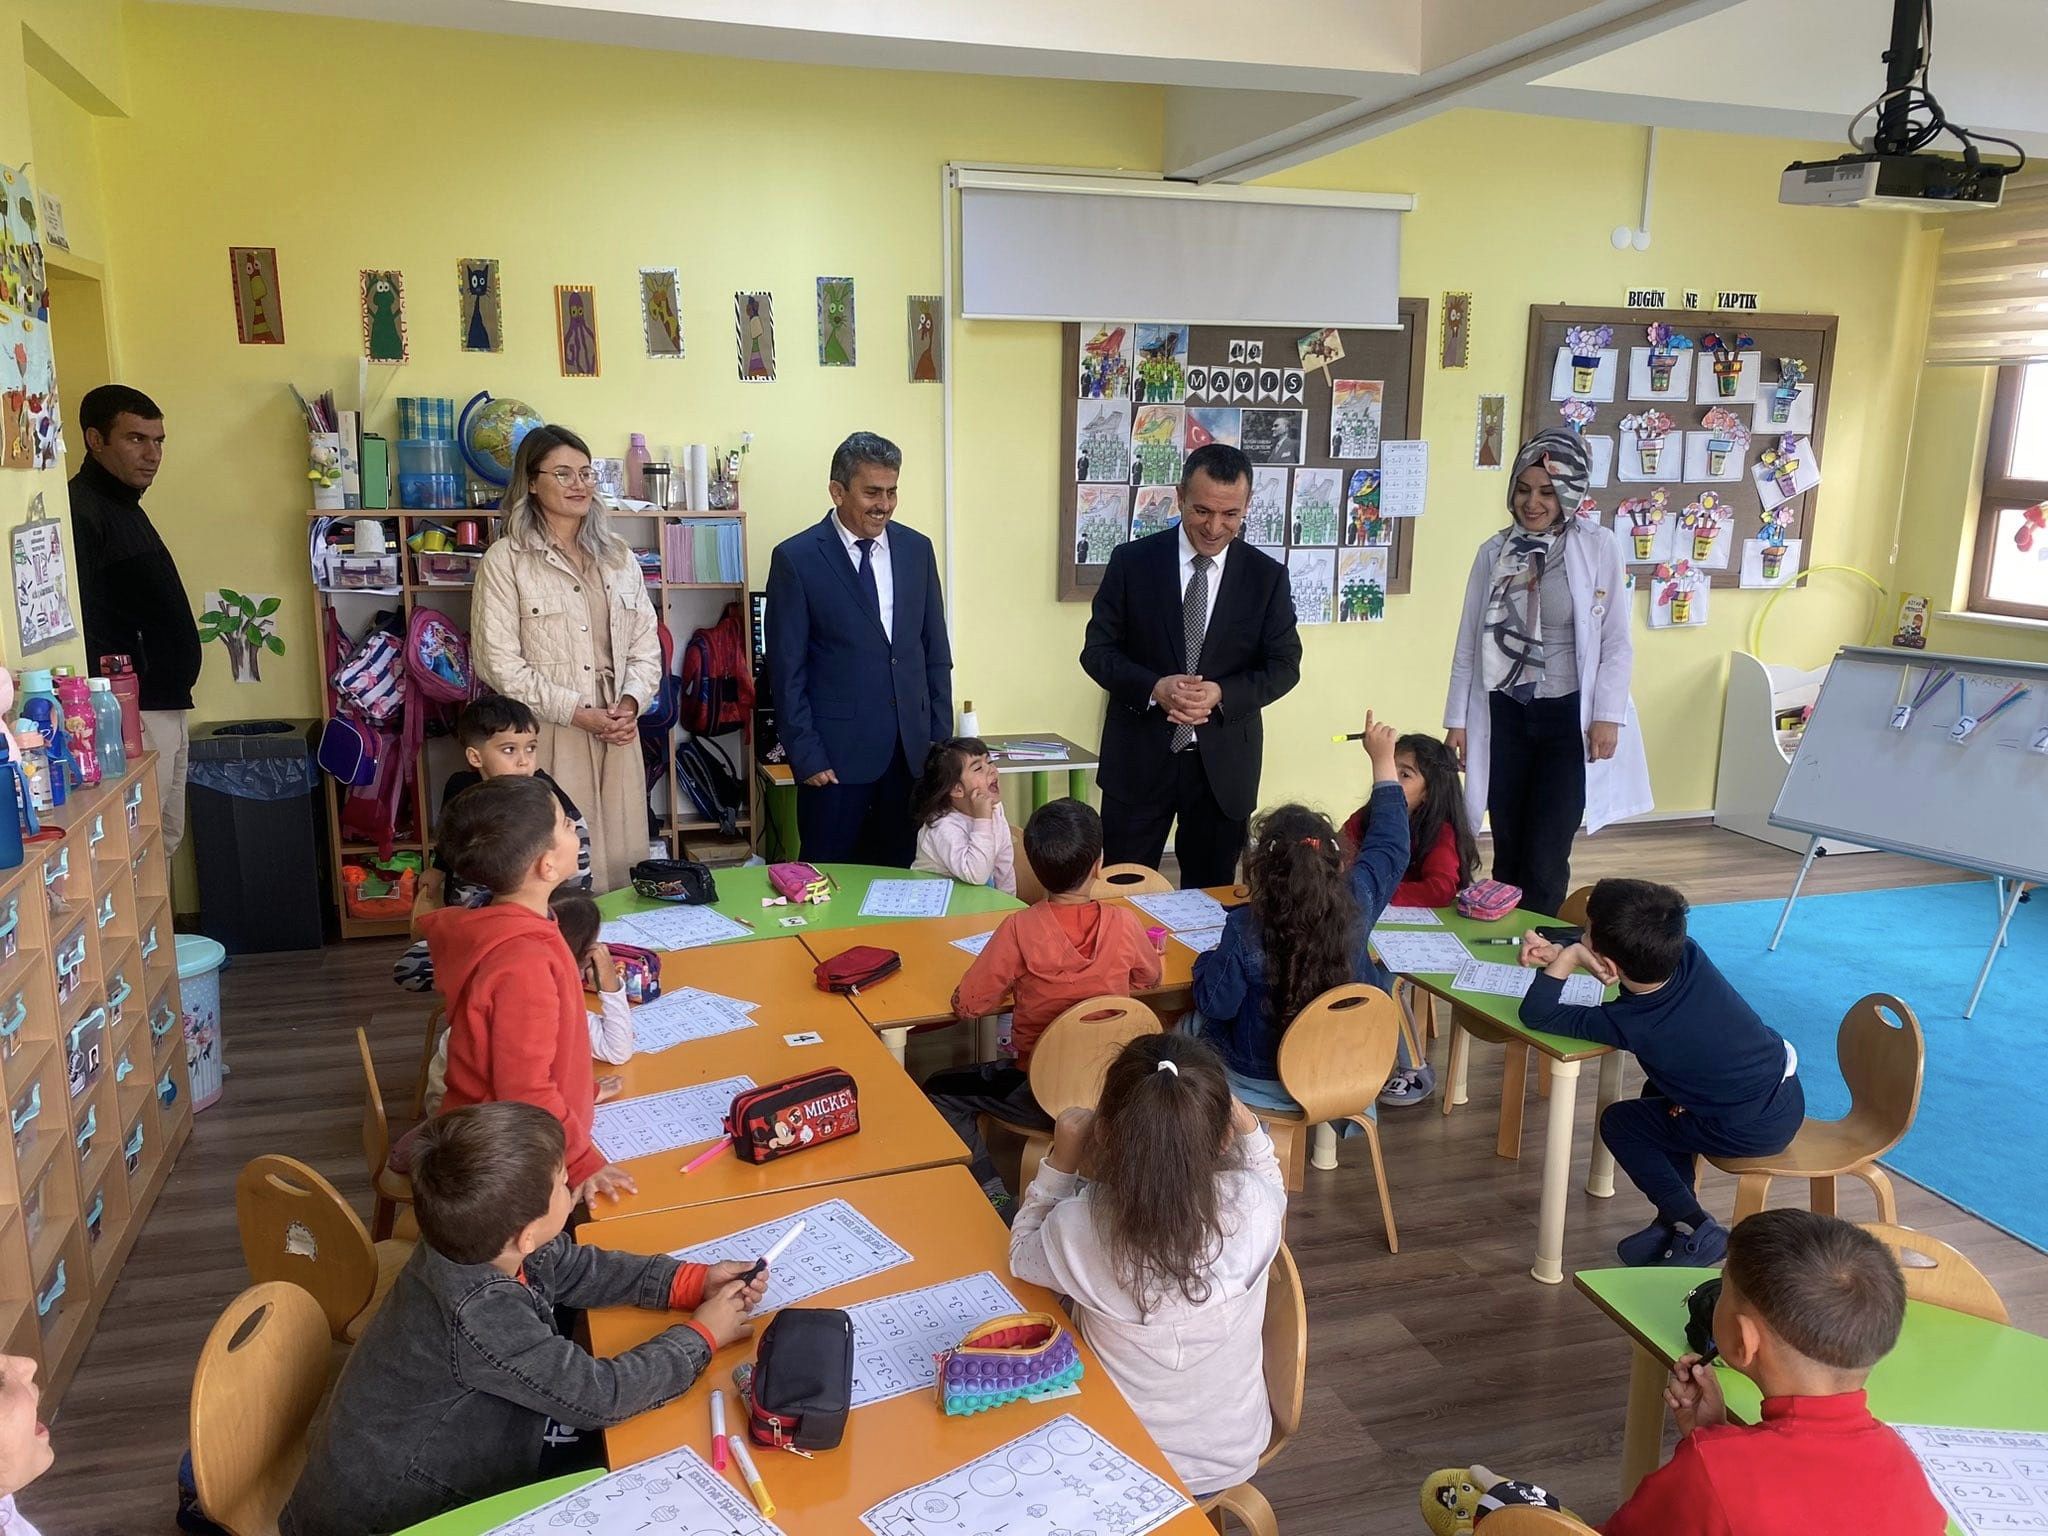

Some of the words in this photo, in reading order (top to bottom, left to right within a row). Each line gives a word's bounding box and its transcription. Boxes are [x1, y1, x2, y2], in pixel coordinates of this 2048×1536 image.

[1628, 290, 1665, 307] BUGÜN
[1685, 292, 1698, 308] NE
[1718, 292, 1757, 309] YAPTIK
[1190, 373, 1297, 390] MAYIS
[1892, 706, 1907, 725] 7
[1952, 718, 1974, 736] 5
